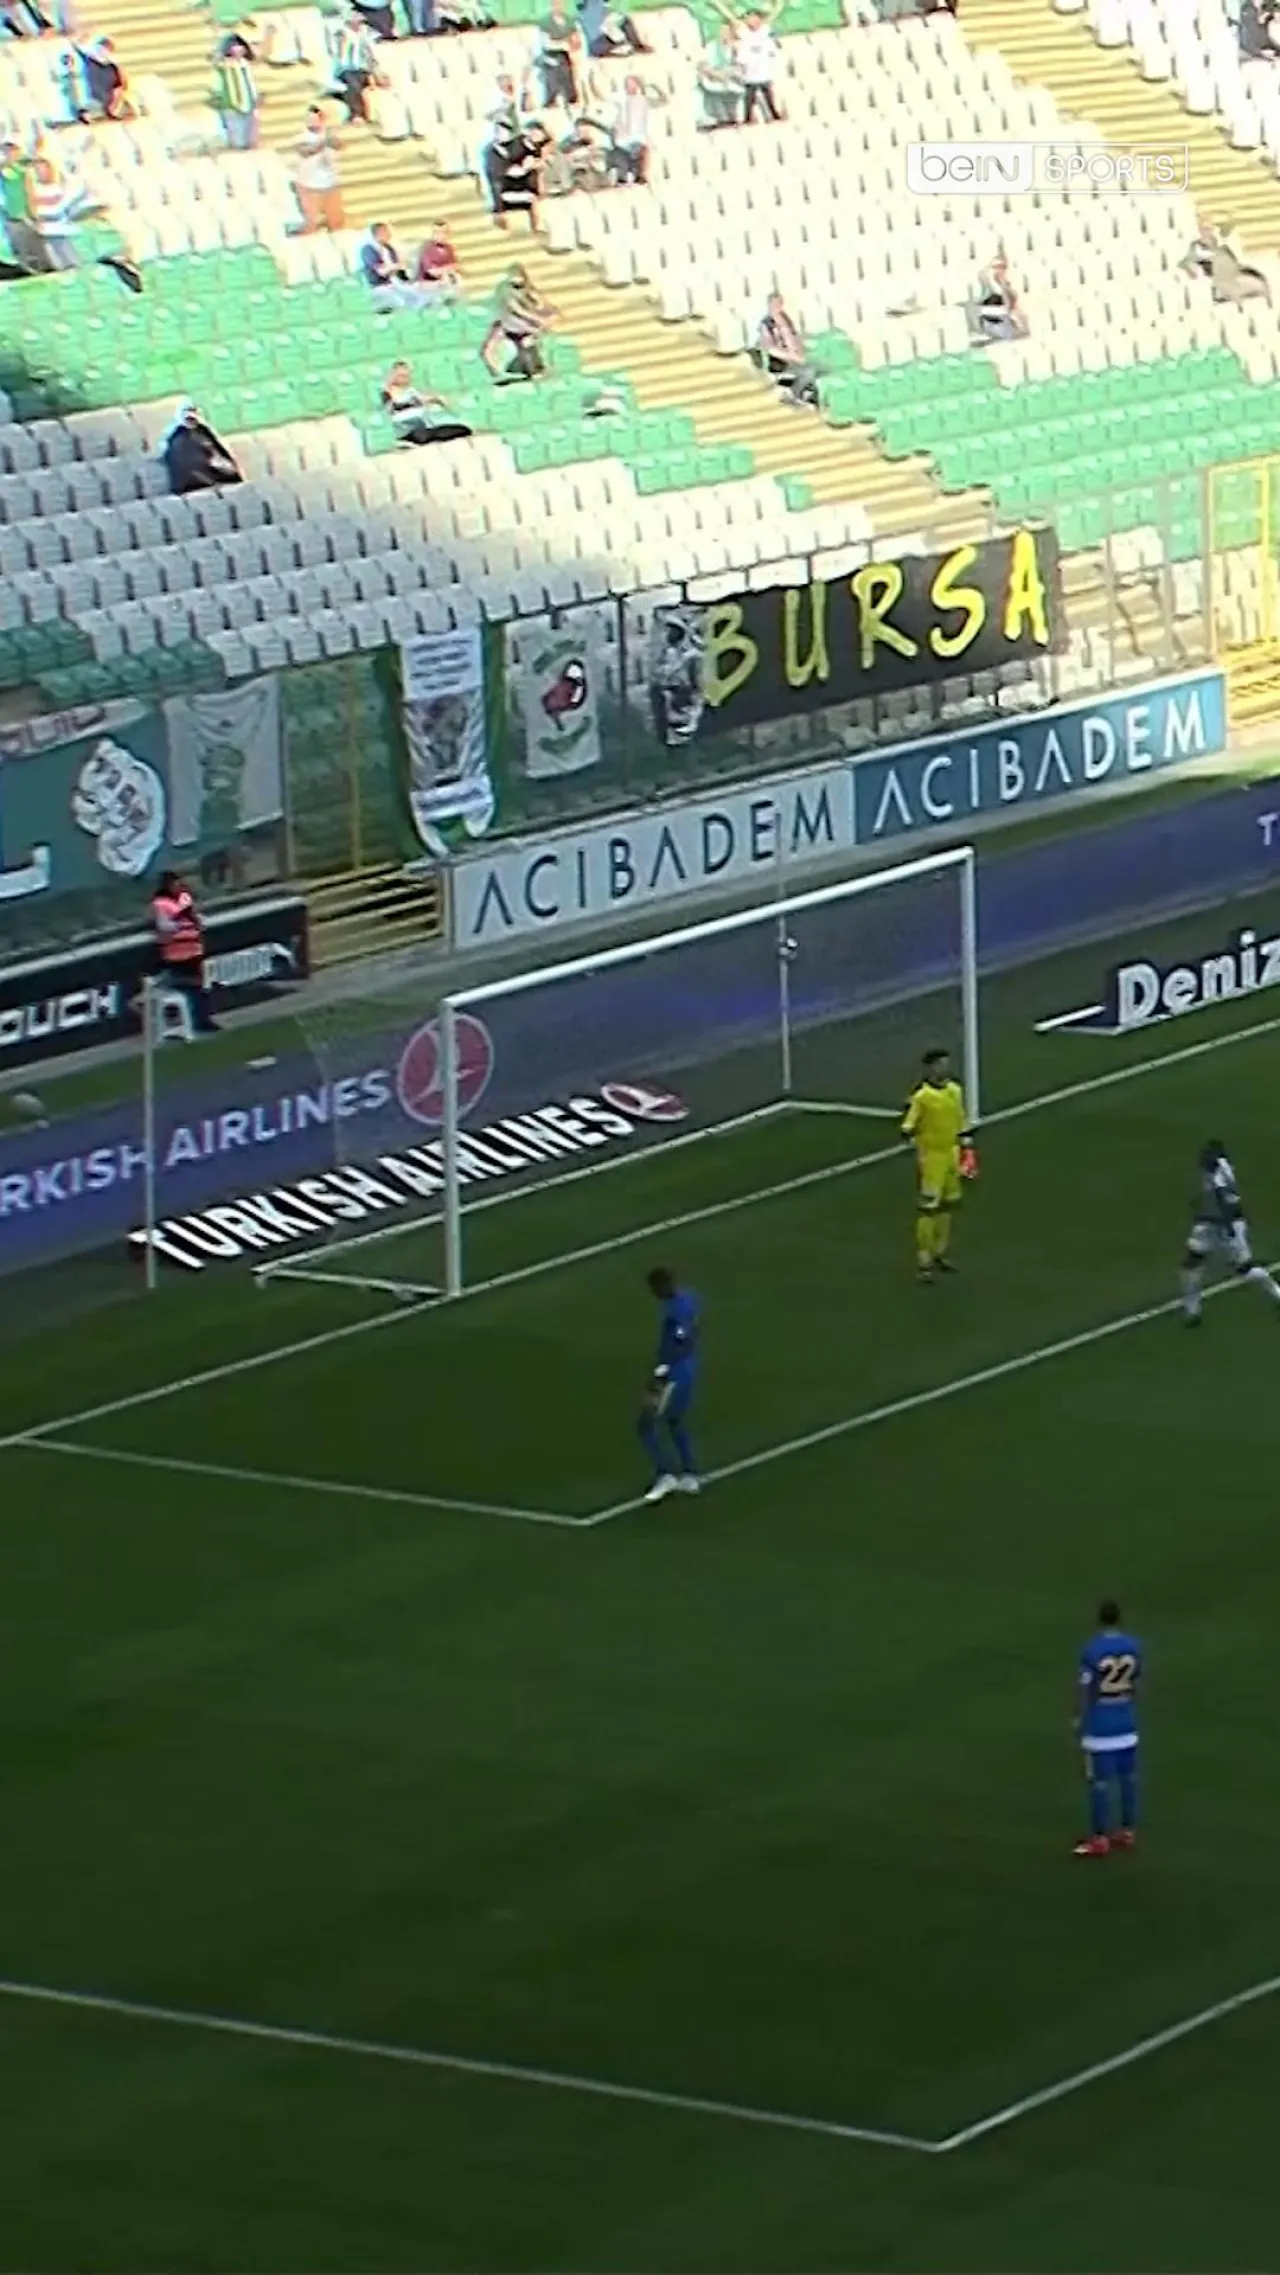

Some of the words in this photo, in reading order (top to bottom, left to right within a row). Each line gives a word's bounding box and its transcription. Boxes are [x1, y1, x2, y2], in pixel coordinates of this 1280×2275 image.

[703, 530, 1051, 707] BURSA
[872, 690, 1206, 836] ACIBADEM
[472, 782, 834, 934] ACIBADEM
[128, 1164, 406, 1269] TURKISH
[377, 1098, 637, 1197] AIRLINES
[164, 1069, 391, 1167] AIRLINES
[1098, 1654, 1136, 1693] 22
